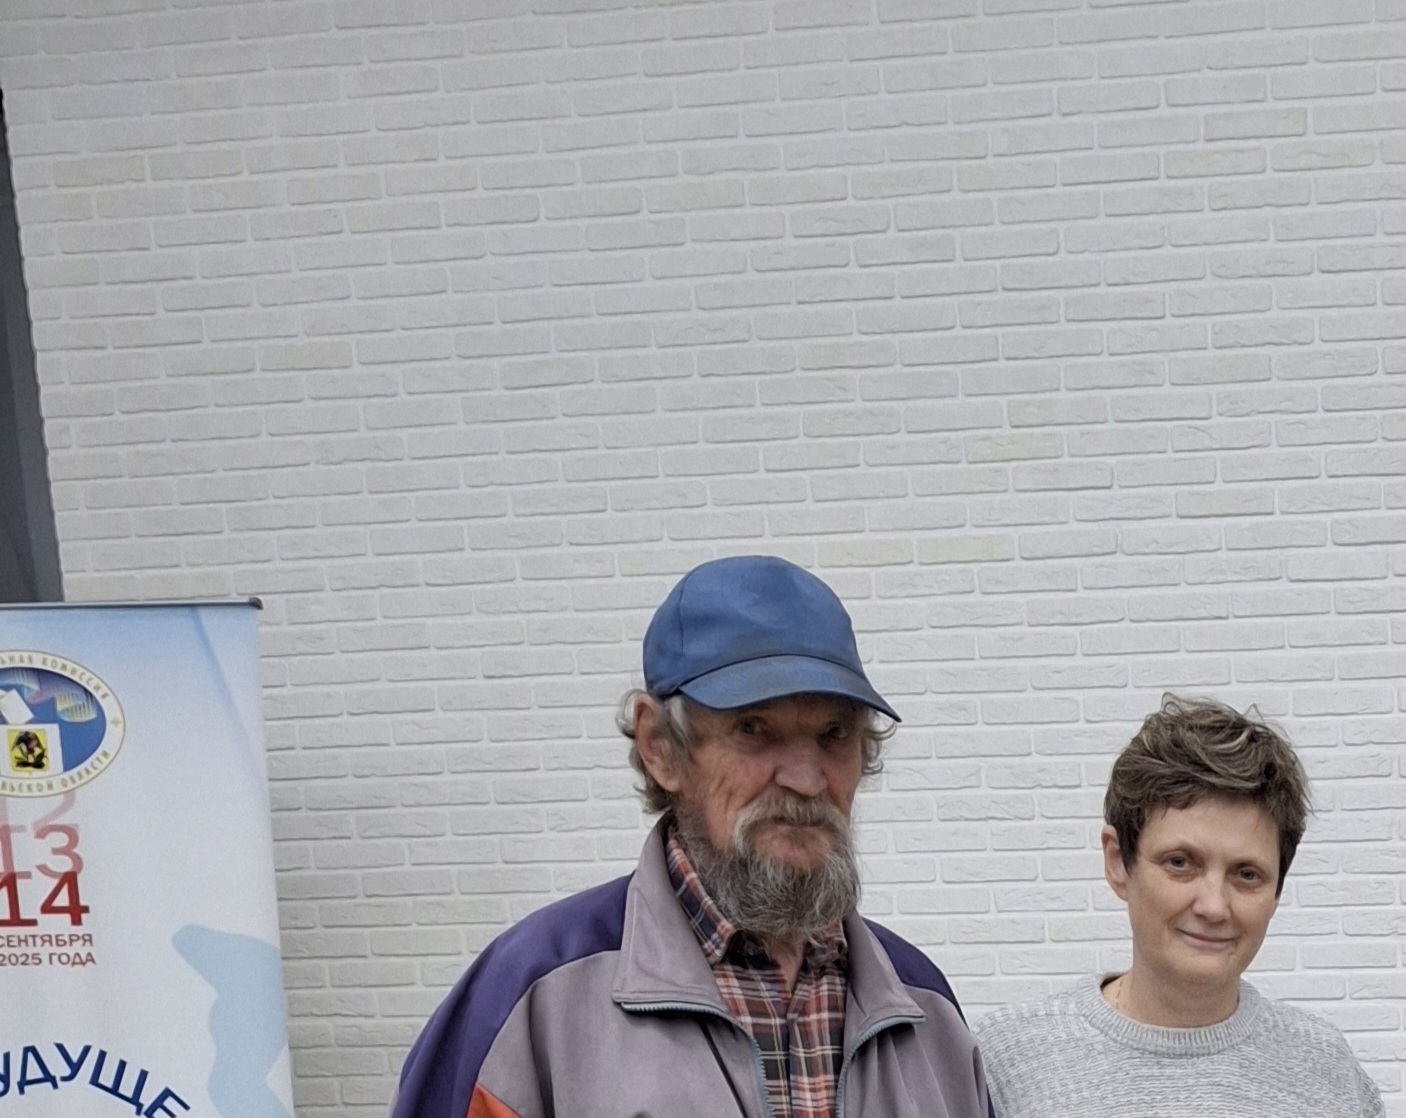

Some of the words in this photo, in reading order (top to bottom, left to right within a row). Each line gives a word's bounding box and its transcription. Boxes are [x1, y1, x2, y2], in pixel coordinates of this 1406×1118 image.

[0, 871, 90, 927] 14
[0, 953, 42, 967] 2025
[49, 952, 96, 967] ГОДА
